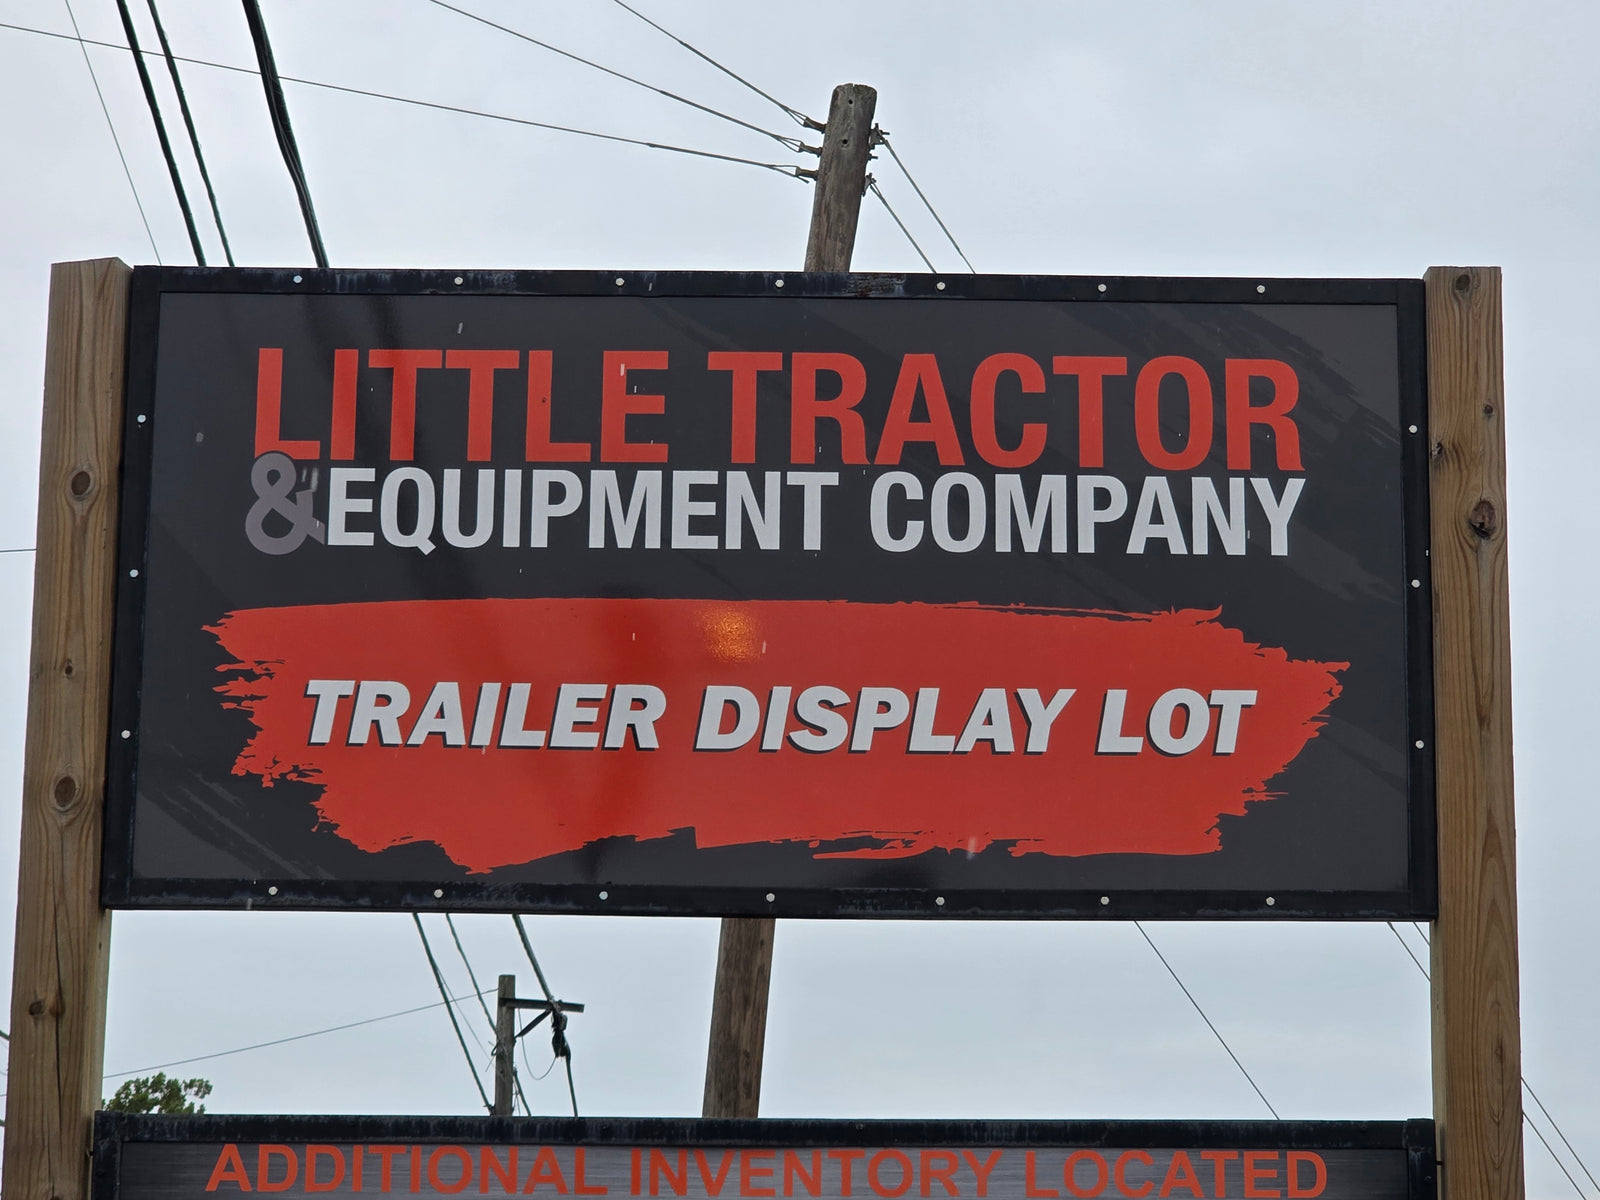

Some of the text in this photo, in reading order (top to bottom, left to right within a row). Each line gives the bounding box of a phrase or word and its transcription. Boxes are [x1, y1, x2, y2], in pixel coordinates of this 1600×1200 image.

[254, 348, 1305, 472] LITTLE TRACTOR
[327, 467, 840, 556] EQUIPMENT
[869, 472, 1306, 556] COMPANY
[305, 679, 1258, 756] TRAILER DISPLAY LOT
[205, 1143, 1328, 1200] ADDITIONAL INVENTORY LOCATED
